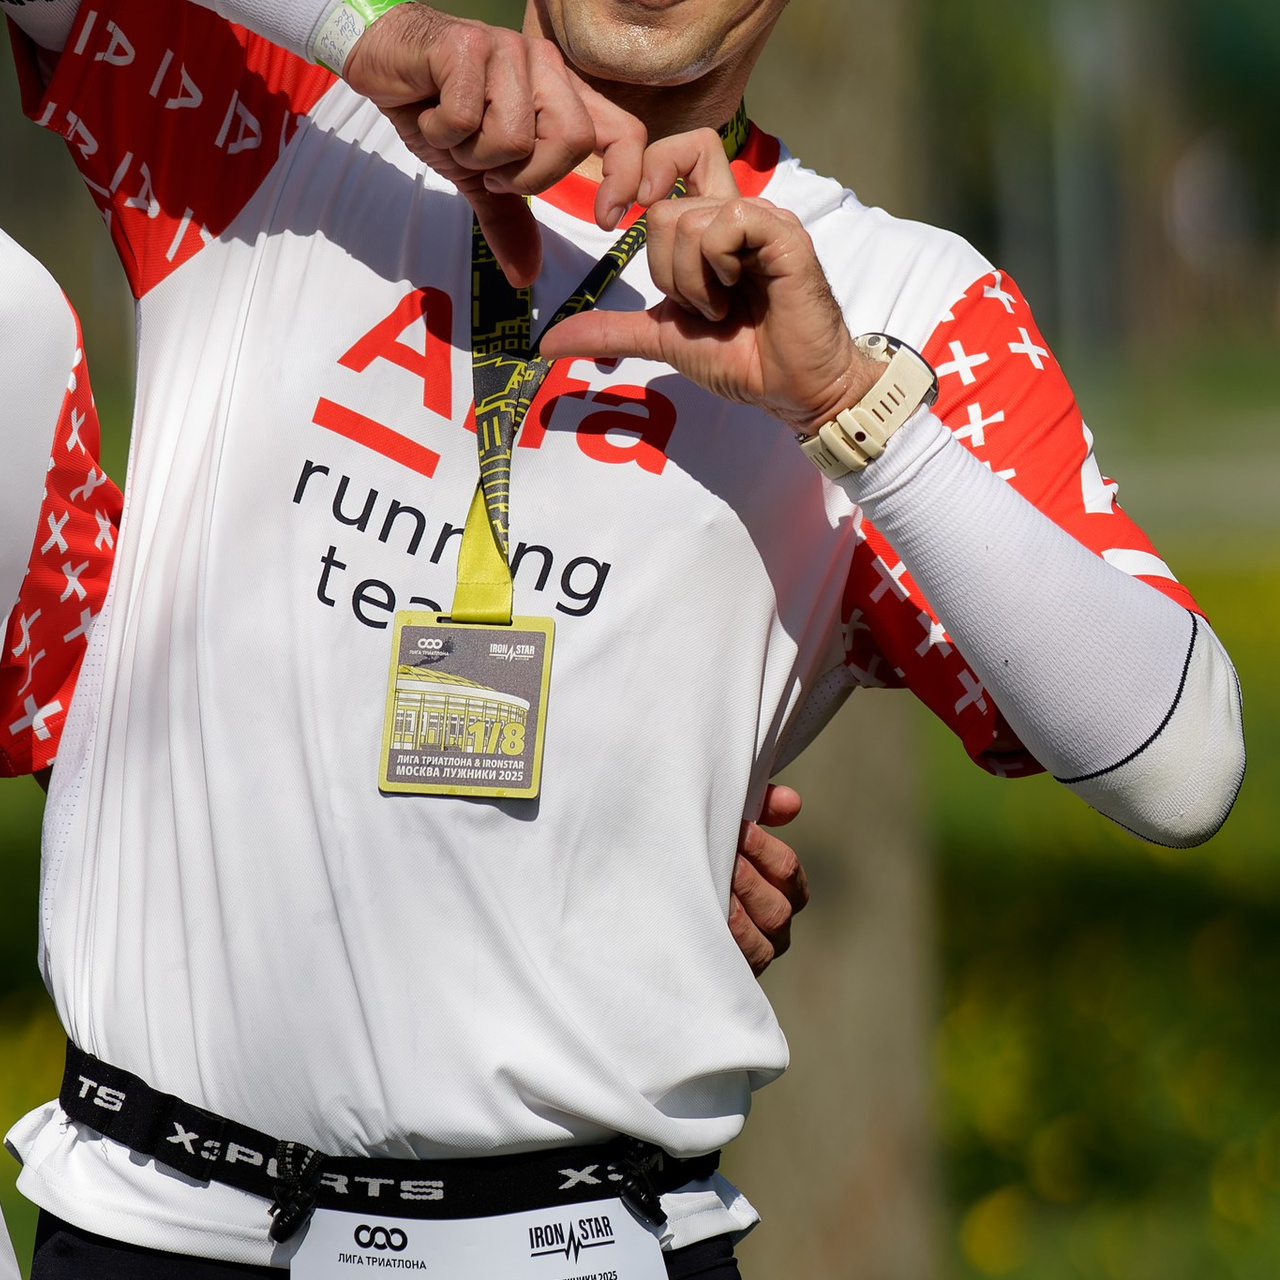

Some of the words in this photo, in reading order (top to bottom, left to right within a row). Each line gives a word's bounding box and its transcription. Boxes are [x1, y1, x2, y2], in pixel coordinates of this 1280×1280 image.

[337, 286, 678, 476] Afa
[292, 459, 611, 617] runnng
[515, 644, 535, 655] STAR
[468, 720, 526, 756] 1/8
[396, 765, 440, 777] МОСКВА
[442, 768, 496, 780] ЛУЖНИКИ
[498, 770, 524, 781] 2025
[397, 754, 419, 764] ЛИГА
[422, 756, 473, 767] ТРИАТЛОНА
[474, 758, 481, 767] &
[482, 758, 524, 769] IRONSTAR
[529, 1222, 566, 1249] IRON
[580, 1216, 614, 1239] STAR
[338, 1252, 364, 1265] ЛИГА
[366, 1255, 427, 1270] ТРИАТЛОНА
